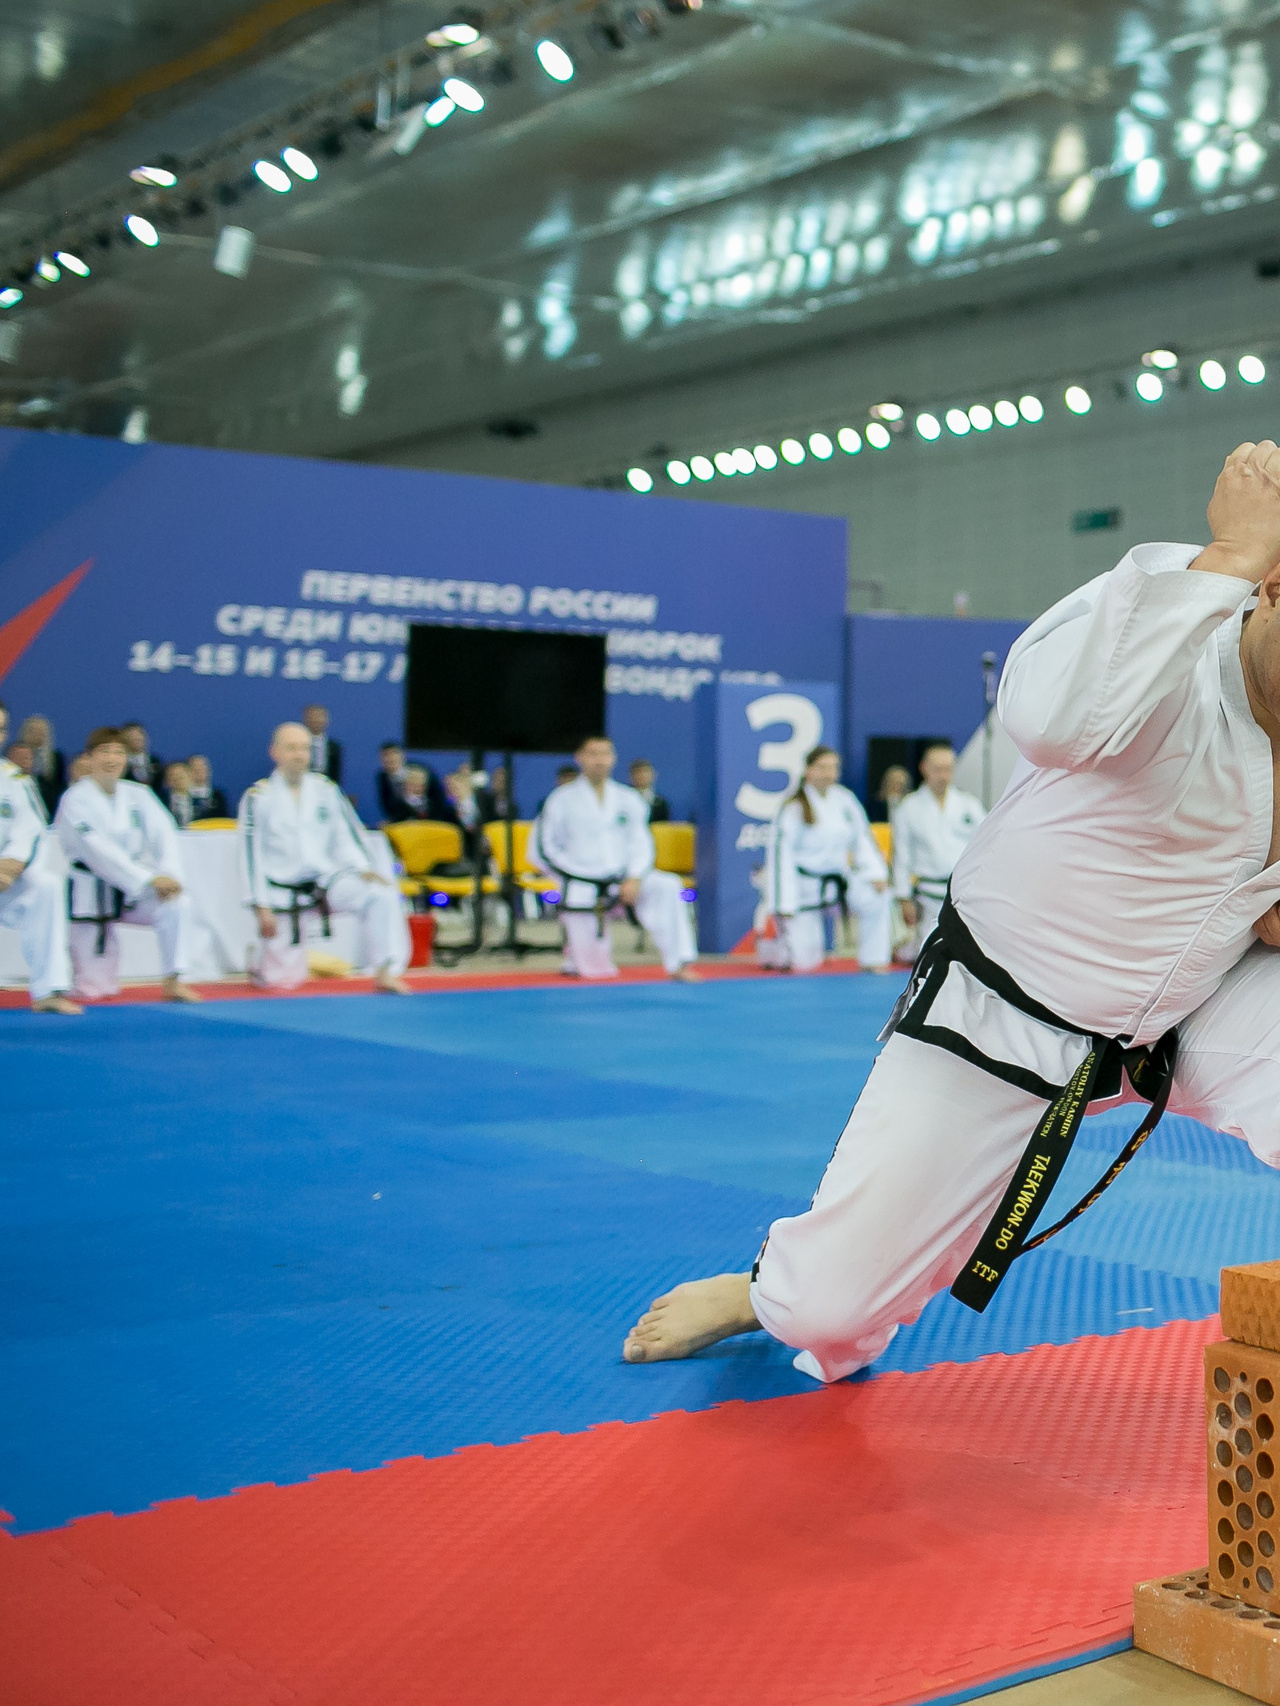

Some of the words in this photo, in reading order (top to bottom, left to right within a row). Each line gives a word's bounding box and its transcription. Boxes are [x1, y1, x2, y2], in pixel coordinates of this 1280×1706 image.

[215, 603, 343, 646] СРЕДИ
[301, 568, 525, 616] ПЕРВЕНСТВО
[528, 585, 659, 625] РОССИИ
[735, 693, 823, 821] 3
[995, 1154, 1051, 1250] TAEKWON-DO
[972, 1261, 999, 1282] ITF
